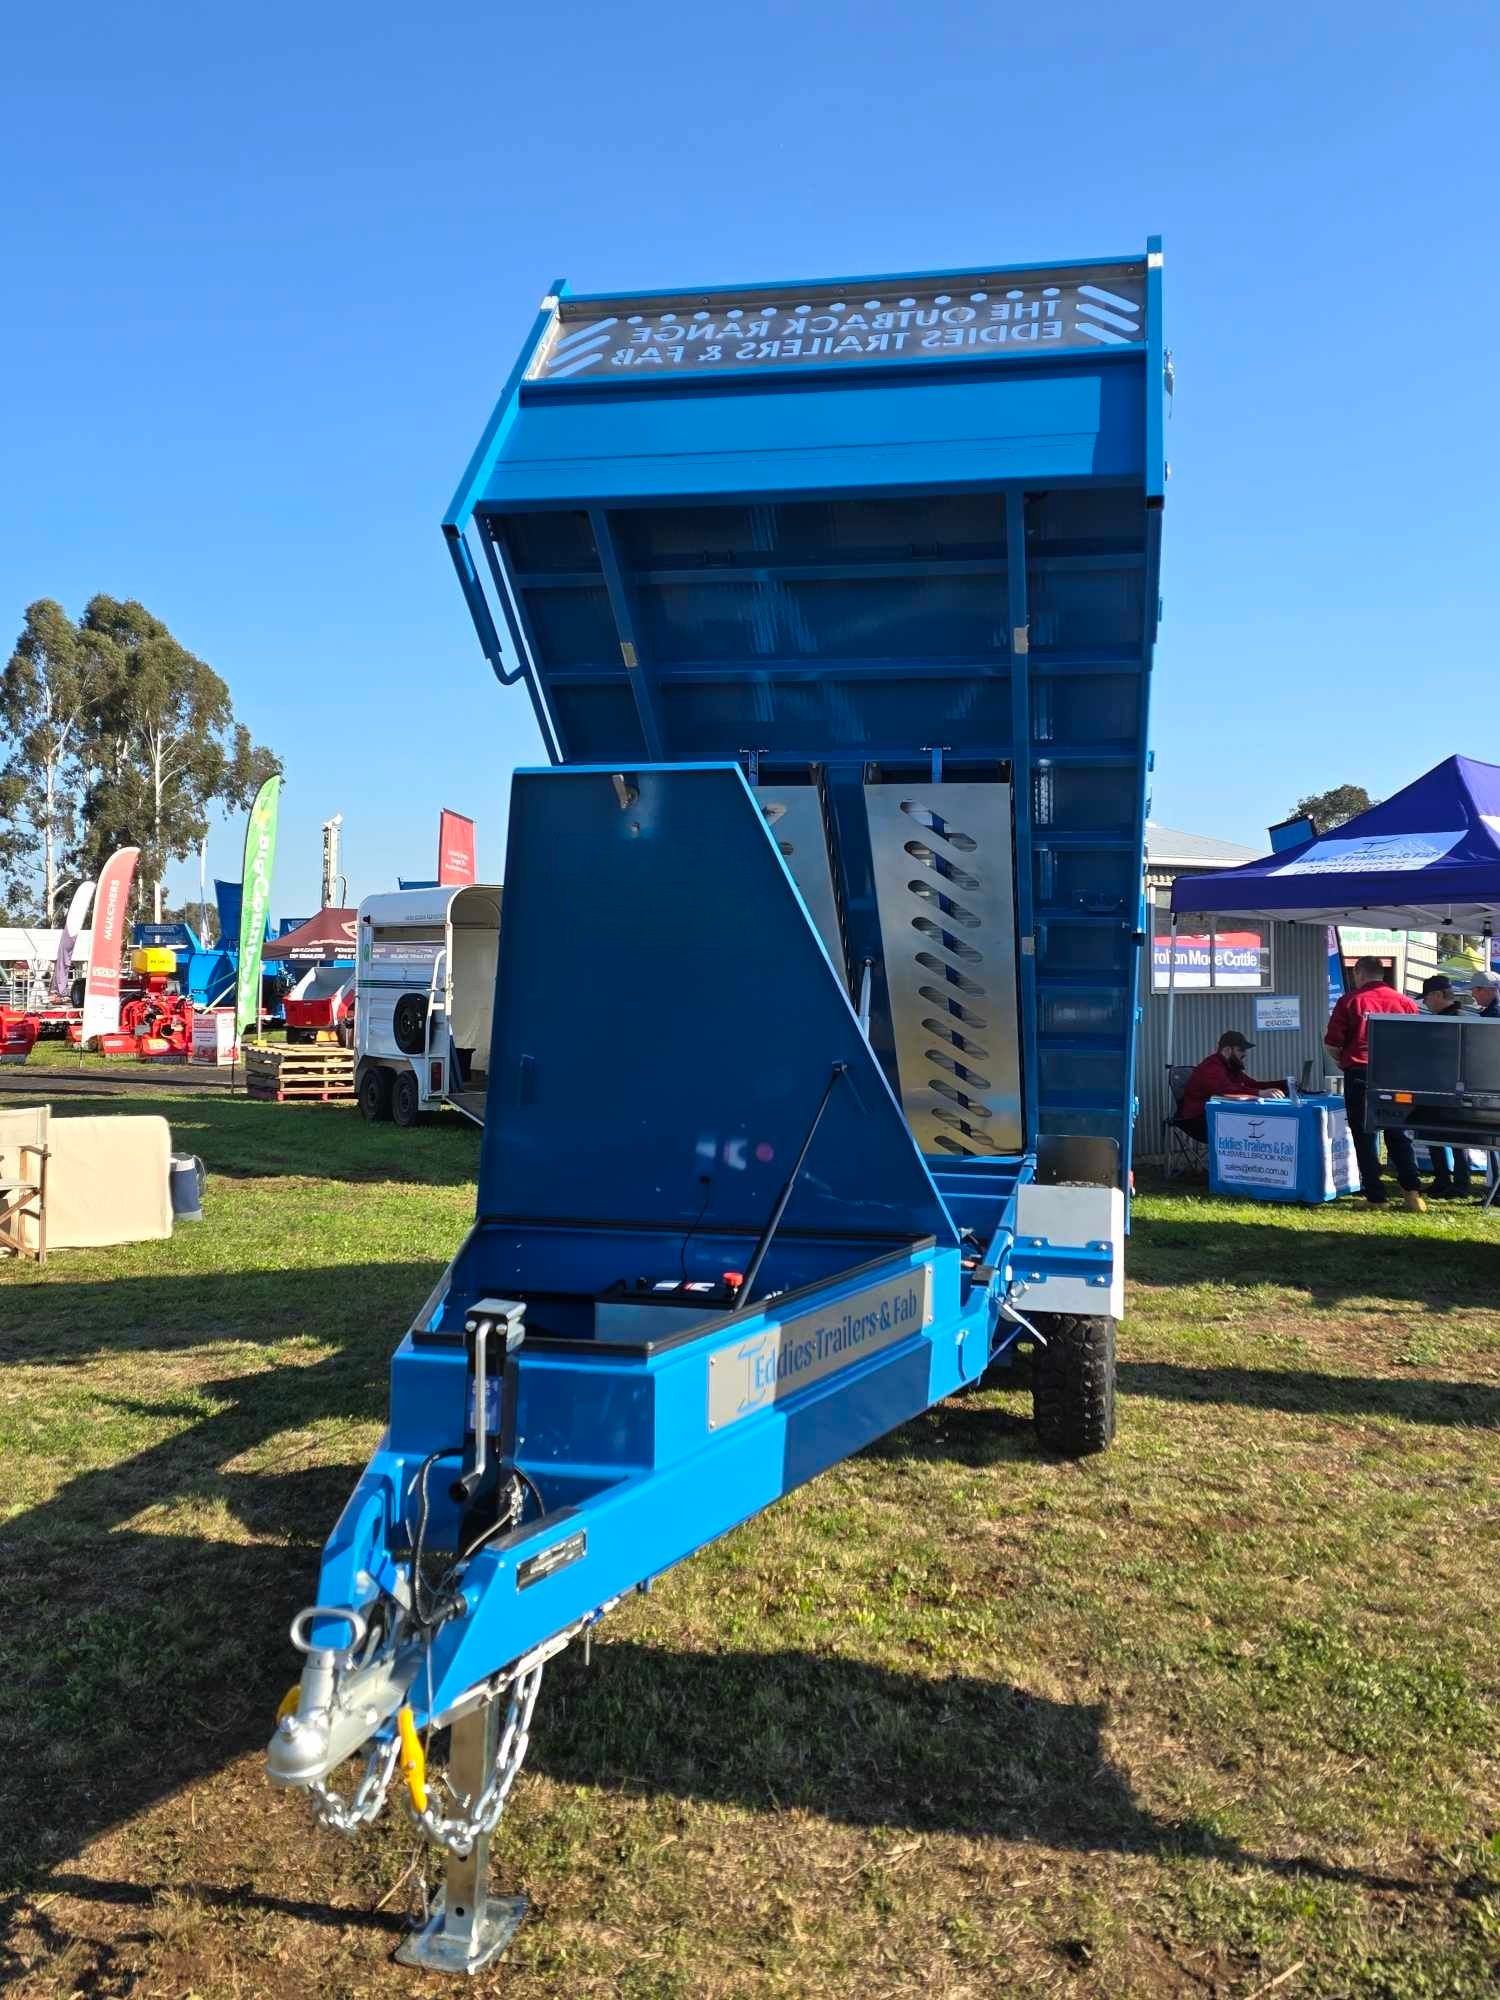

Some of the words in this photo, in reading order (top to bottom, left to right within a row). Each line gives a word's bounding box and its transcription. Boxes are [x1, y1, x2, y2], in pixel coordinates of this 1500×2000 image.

[103, 880, 120, 941] MULCHERS
[1189, 950, 1223, 965] Mae
[1224, 951, 1258, 966] Cattle
[1218, 1136, 1242, 1150] Eddies
[1243, 1139, 1272, 1153] Trailers
[1273, 1141, 1280, 1154] &
[1280, 1142, 1295, 1156] Fab
[754, 1338, 815, 1390] Eddies
[815, 1314, 878, 1361] Trailers
[878, 1301, 892, 1330] &
[893, 1288, 918, 1324] Fab
